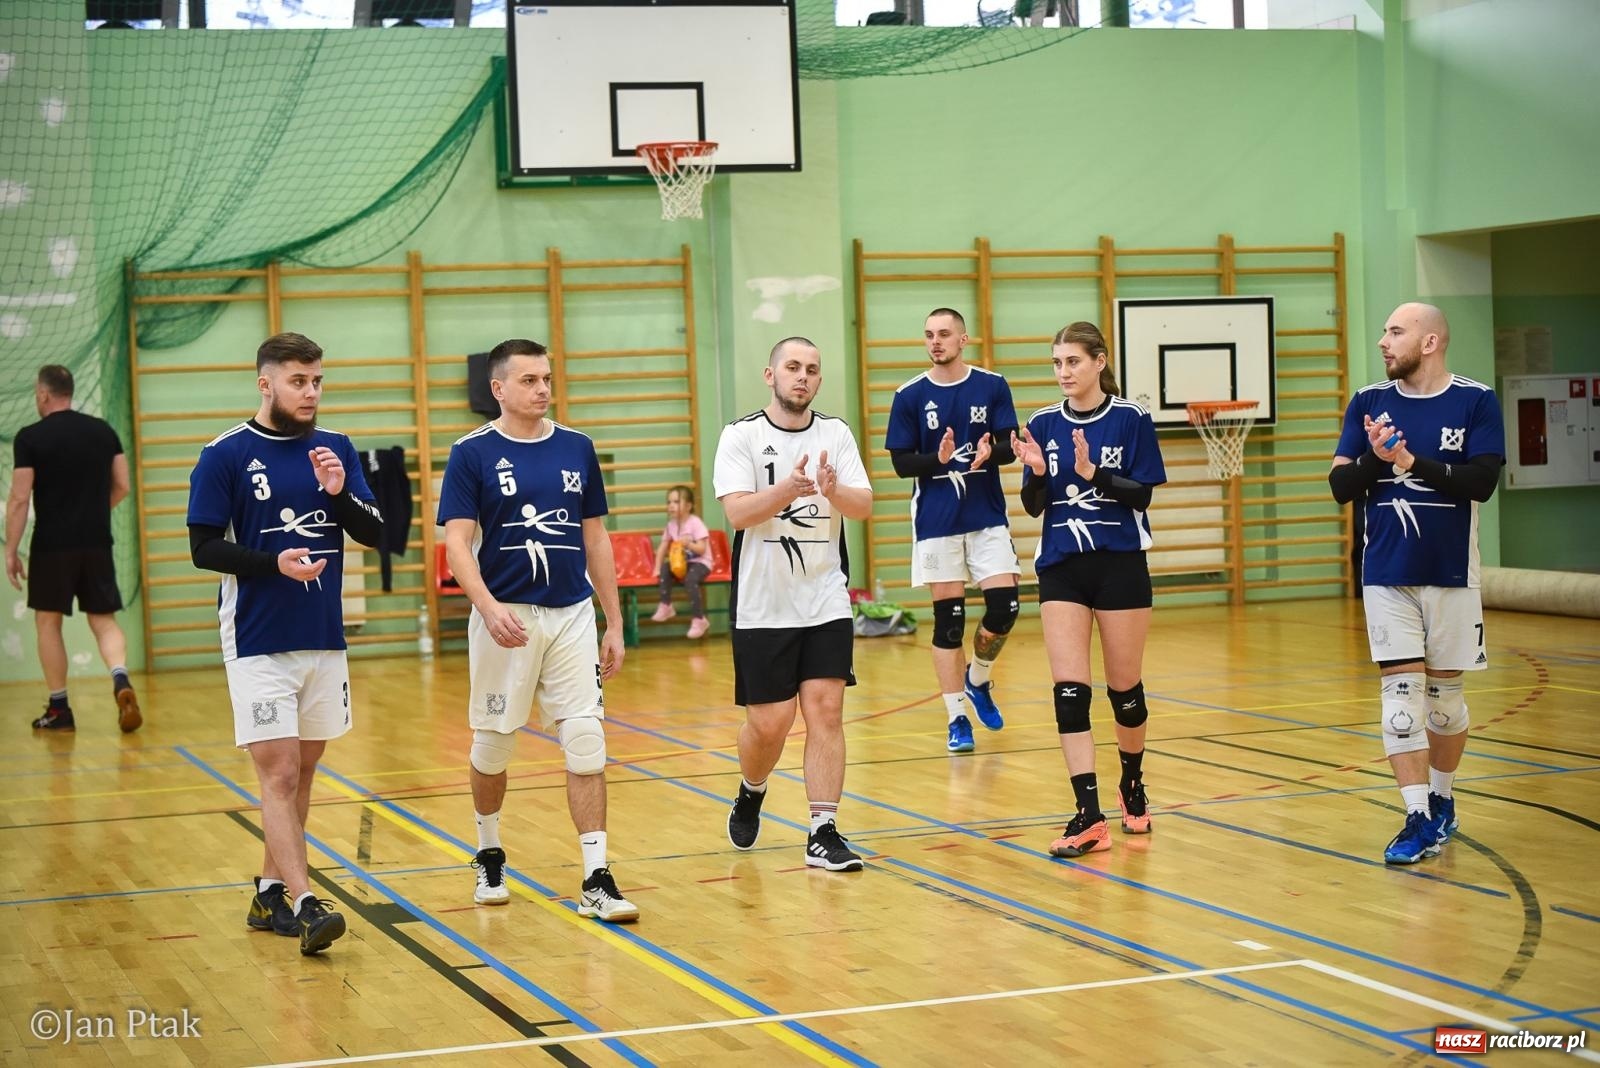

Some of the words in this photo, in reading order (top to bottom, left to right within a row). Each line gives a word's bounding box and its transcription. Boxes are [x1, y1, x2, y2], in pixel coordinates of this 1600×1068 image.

[926, 411, 939, 430] 8
[764, 462, 775, 485] 1
[1049, 452, 1058, 477] 6
[251, 473, 271, 501] 3
[498, 471, 517, 496] 5
[1474, 623, 1484, 646] 7
